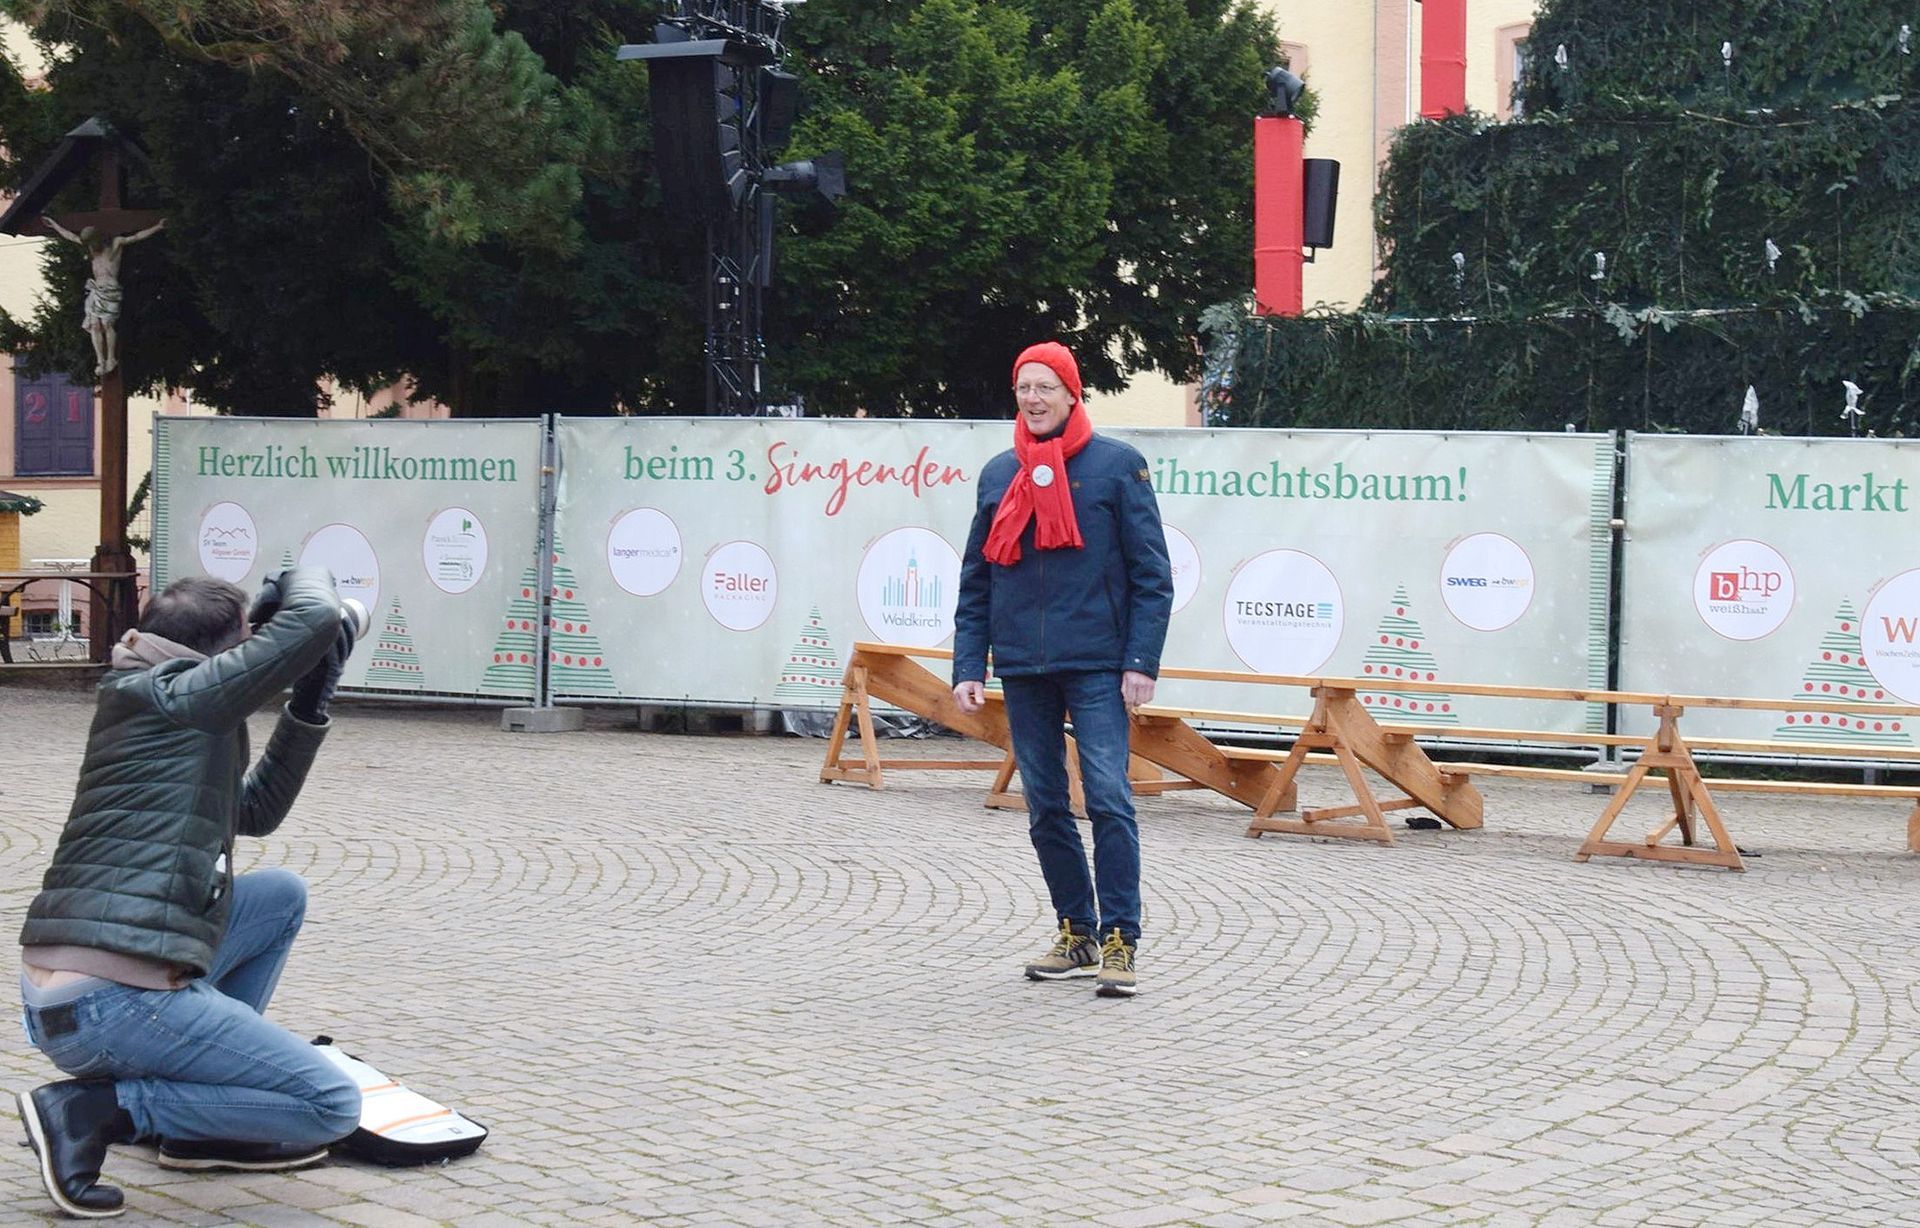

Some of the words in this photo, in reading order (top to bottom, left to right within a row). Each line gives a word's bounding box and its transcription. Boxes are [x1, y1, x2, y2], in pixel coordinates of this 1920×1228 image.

[197, 445, 319, 478] Herzlich
[326, 446, 517, 482] willkommen
[624, 445, 715, 480] beim
[726, 449, 757, 481] 3.
[763, 441, 971, 517] Singenden
[1765, 472, 1909, 512] Markt
[715, 573, 768, 592] Faller
[1447, 577, 1487, 587] SWEG
[1237, 601, 1315, 618] TECSTAGE
[1710, 604, 1768, 614] weißhaar
[882, 613, 941, 627] Waldkirch
